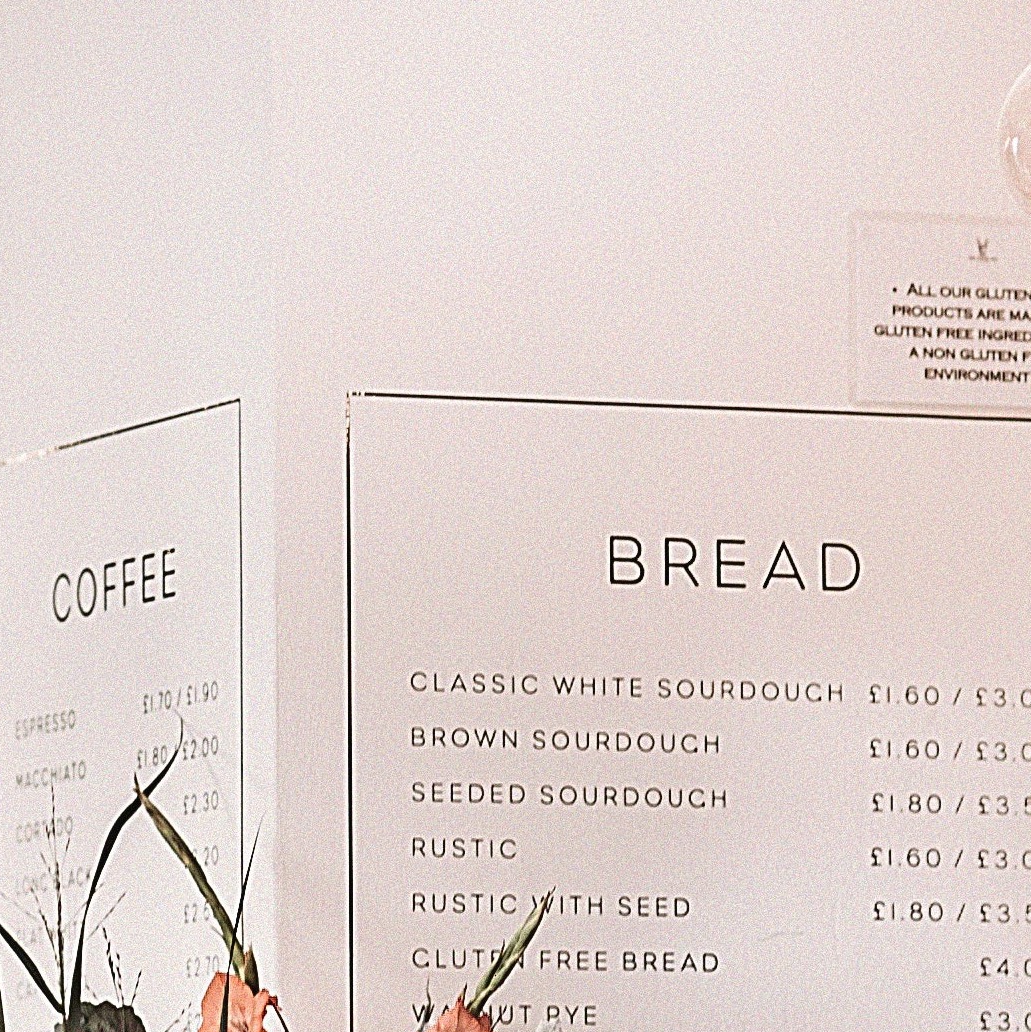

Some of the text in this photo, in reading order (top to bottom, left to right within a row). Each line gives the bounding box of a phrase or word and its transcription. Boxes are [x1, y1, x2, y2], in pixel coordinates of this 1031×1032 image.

[906, 283, 937, 298] ALL
[940, 285, 971, 299] OUR
[892, 304, 973, 319] PRODUCTS
[976, 308, 1005, 321] ARE
[874, 324, 932, 338] GLUTEN
[936, 327, 974, 340] FREE
[908, 346, 919, 358] A
[923, 347, 956, 360] NON
[960, 349, 1018, 362] GLUTEN
[924, 366, 1030, 383] ENVIRONMENT
[609, 534, 861, 592] BREAD
[52, 547, 176, 623] COFFEE
[142, 689, 173, 715] £1.70
[186, 680, 219, 706] £1.90
[409, 670, 539, 695] CLASSIC
[552, 674, 643, 698] WHITE
[657, 677, 844, 702] SOURDOUGH
[869, 683, 940, 706] £1.60
[952, 687, 962, 706] /
[15, 708, 77, 741] ESPRESSO
[136, 744, 169, 770] £1.80
[411, 726, 518, 749] BROWN
[532, 728, 720, 754] SOURDOUGH
[869, 737, 941, 760] £1.60
[953, 740, 963, 760] /
[15, 760, 87, 789] MACCHIATO
[182, 790, 219, 816] £2.30
[411, 780, 526, 805] SEEDED
[539, 783, 727, 809] SOURDOUGH
[872, 792, 942, 814] £1.80
[955, 794, 965, 815] /
[17, 816, 74, 844] CORDO
[411, 836, 518, 860] RUSTIC
[870, 846, 942, 868] £1.60
[954, 848, 964, 868] /
[411, 892, 518, 915] RUSTIC
[531, 893, 604, 916] WITH
[617, 896, 691, 918] SEED
[873, 900, 944, 922] £1.80
[956, 902, 966, 922] /
[539, 949, 608, 971] FREE
[622, 950, 719, 973] BREAD
[411, 1002, 532, 1025] WUT
